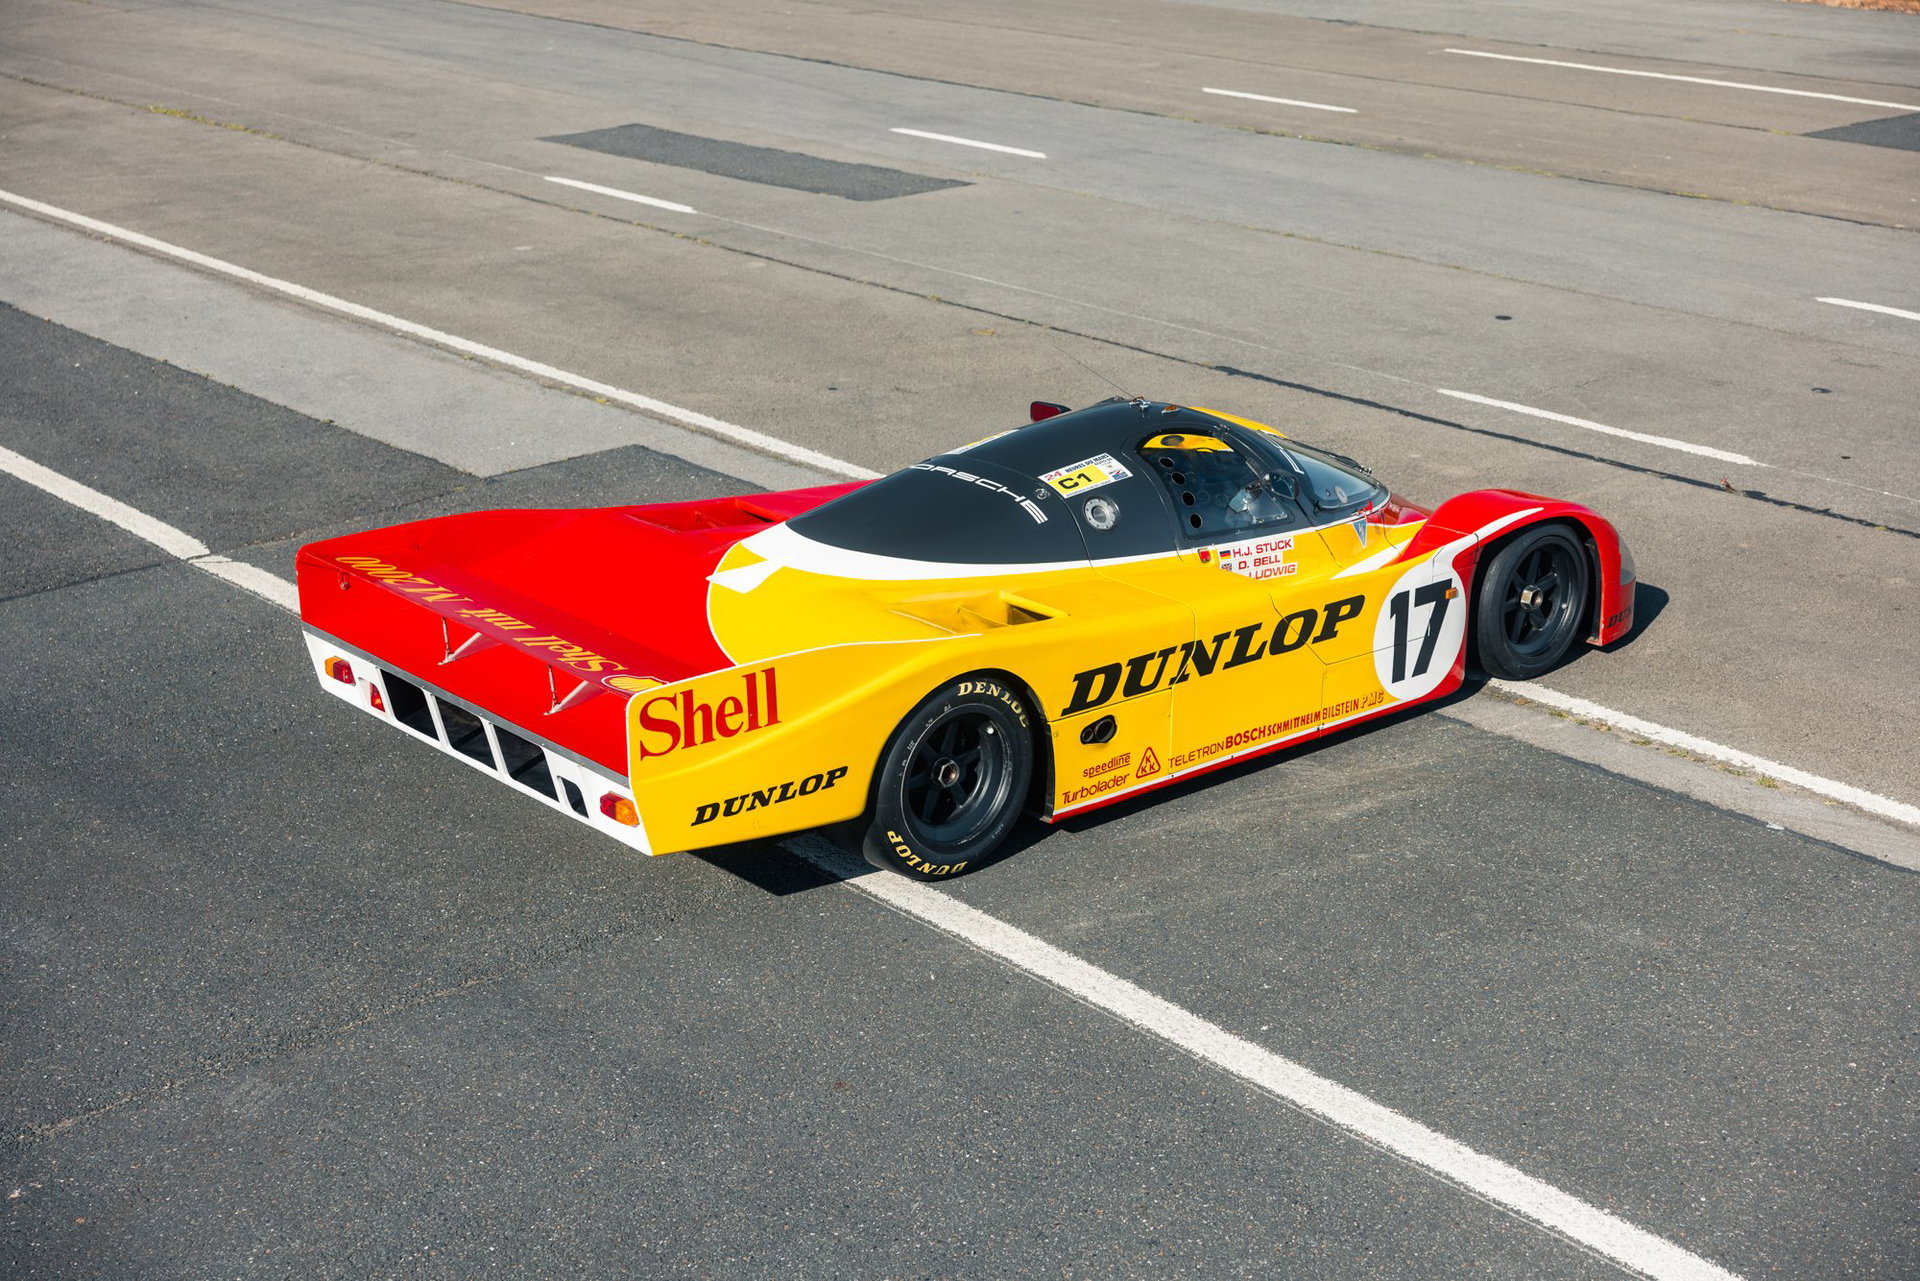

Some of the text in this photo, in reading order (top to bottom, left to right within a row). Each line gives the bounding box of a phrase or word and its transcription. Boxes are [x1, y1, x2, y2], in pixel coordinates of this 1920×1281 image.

[910, 463, 1049, 525] ORSCHE
[1058, 473, 1092, 490] C1
[1238, 554, 1281, 570] D. BELL
[1255, 538, 1292, 554] STUCK
[335, 556, 629, 672] Shell mit M2000
[1390, 578, 1453, 684] 17
[1060, 594, 1366, 717] DUNLOP
[639, 666, 782, 762] Shell
[1168, 741, 1225, 769] TELETRON
[1225, 724, 1267, 750] BOSCH
[1322, 698, 1360, 721] BILSTEIN
[690, 765, 849, 827] DUNLOP
[1062, 773, 1131, 805] Turbolader
[1083, 752, 1131, 778] speedline
[887, 830, 968, 875] DUNLOP
